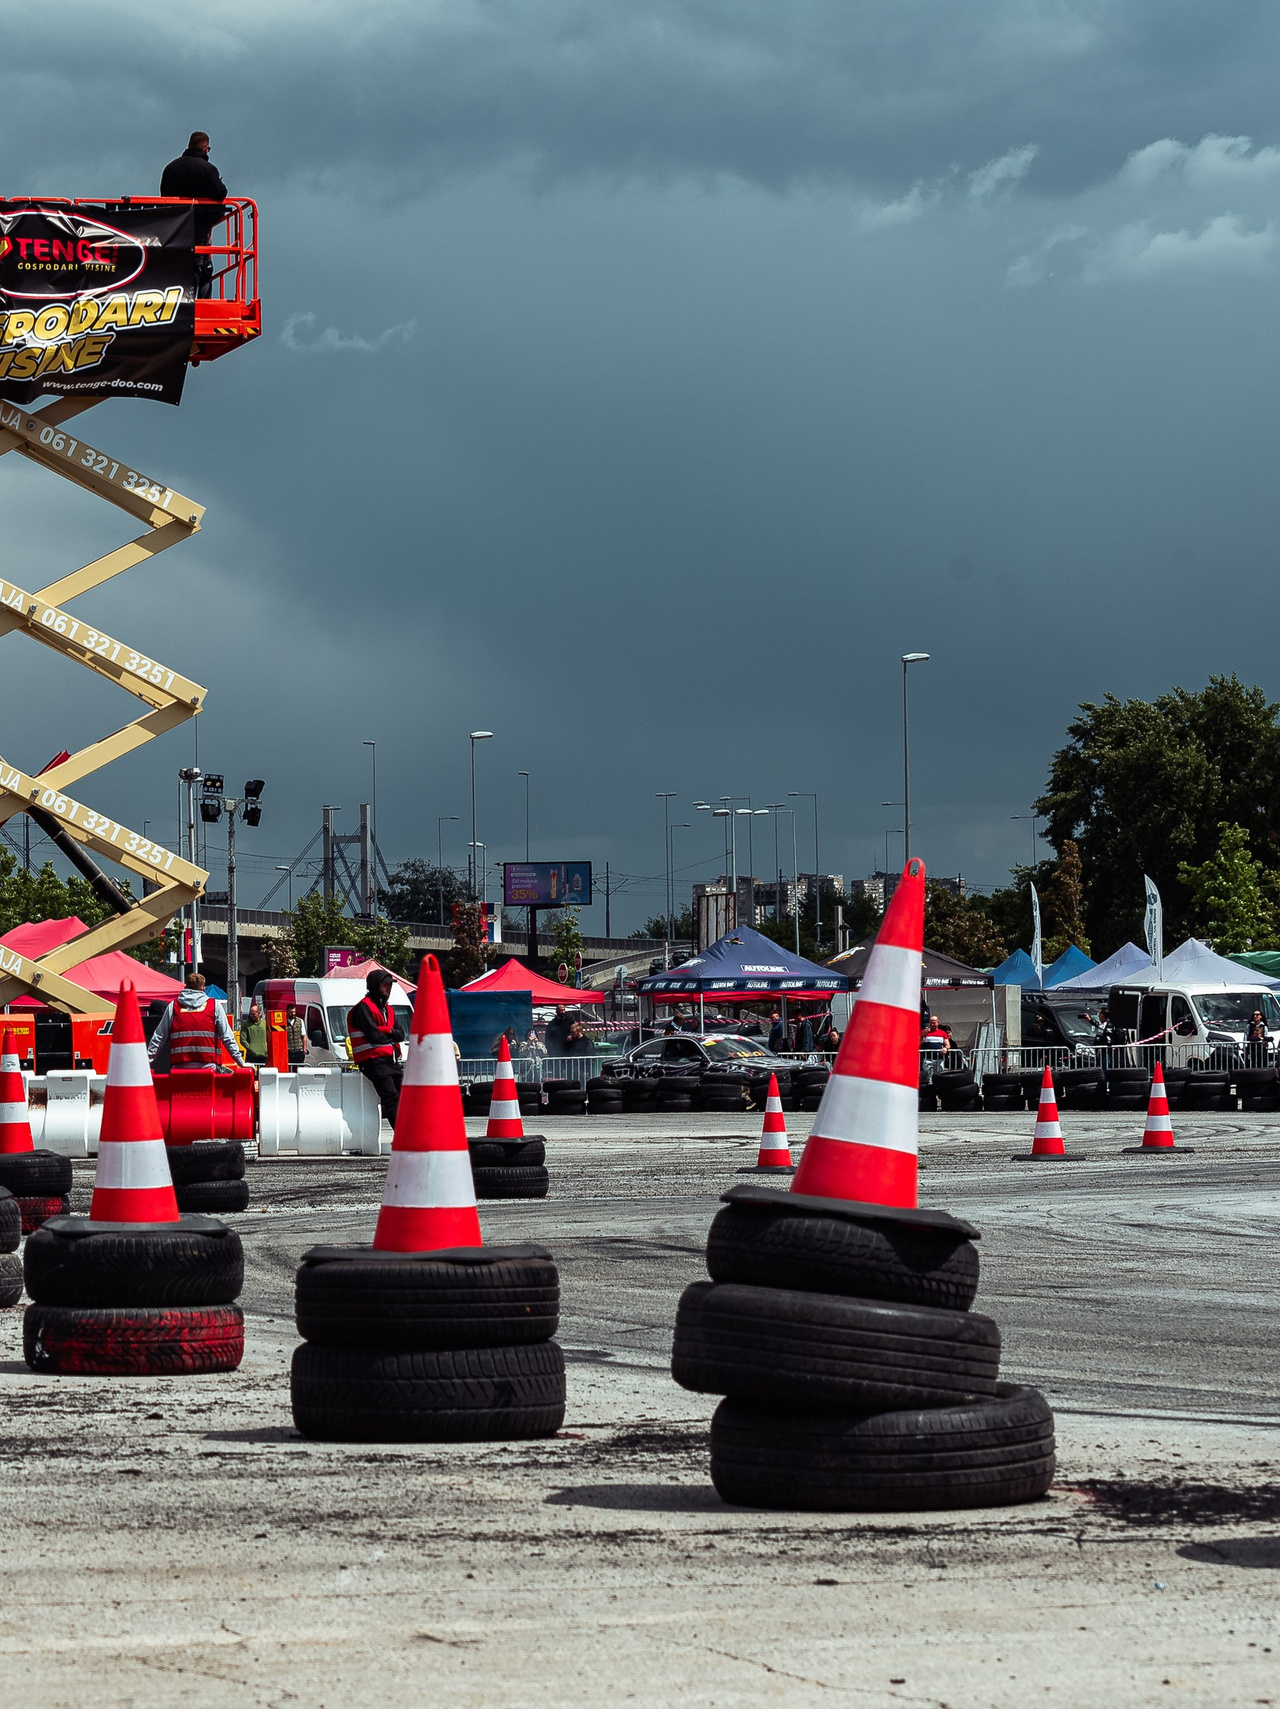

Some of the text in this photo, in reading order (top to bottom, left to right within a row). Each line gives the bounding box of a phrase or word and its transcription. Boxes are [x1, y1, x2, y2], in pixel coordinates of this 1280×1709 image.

[15, 237, 111, 264] TENGE
[17, 262, 116, 273] GOSPODARI VISINE
[42, 378, 164, 392] www.tenge-doo.com
[39, 426, 78, 457] 061
[81, 449, 120, 480] 321
[122, 471, 173, 509] 3251
[41, 608, 80, 640] 061
[82, 631, 122, 662] 321
[124, 653, 175, 690] 3251
[41, 789, 80, 820] 061
[82, 811, 122, 842] 321
[124, 833, 175, 871] 3251
